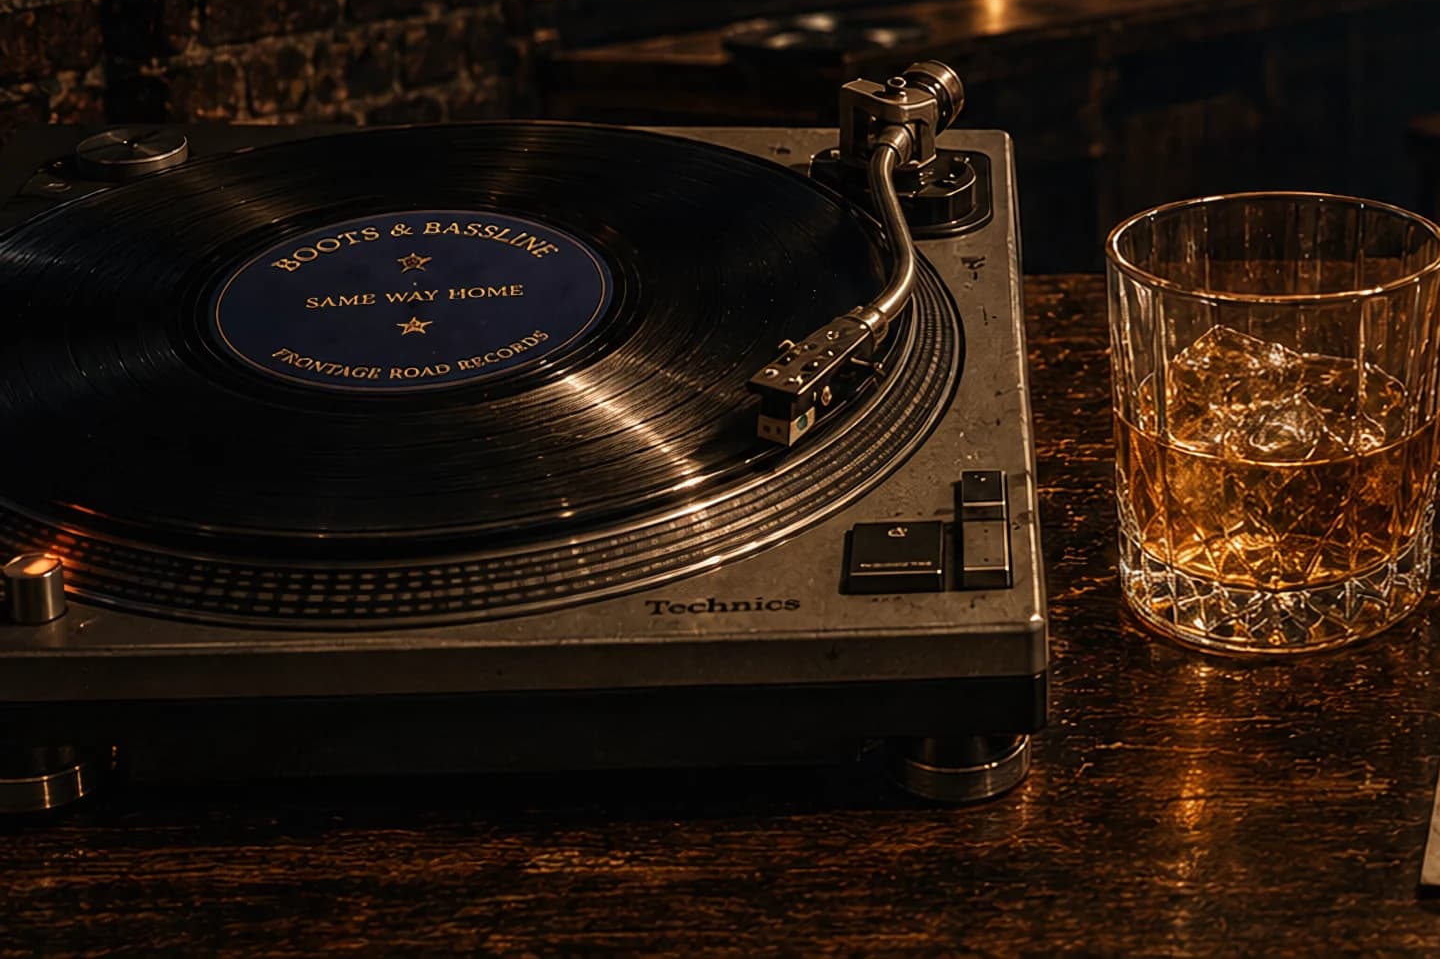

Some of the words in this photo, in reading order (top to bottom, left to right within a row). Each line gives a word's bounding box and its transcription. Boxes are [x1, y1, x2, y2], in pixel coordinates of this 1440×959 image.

[270, 225, 380, 273] BOOTS
[390, 222, 414, 237] &
[423, 220, 560, 259] BASSLINE
[305, 293, 377, 309] SAME
[384, 289, 439, 303] WAY
[449, 284, 525, 300] HOME
[271, 346, 382, 380] FRONTAGE
[389, 363, 451, 379] ROAD
[458, 329, 550, 372] RECORDS
[645, 597, 801, 616] Technics
